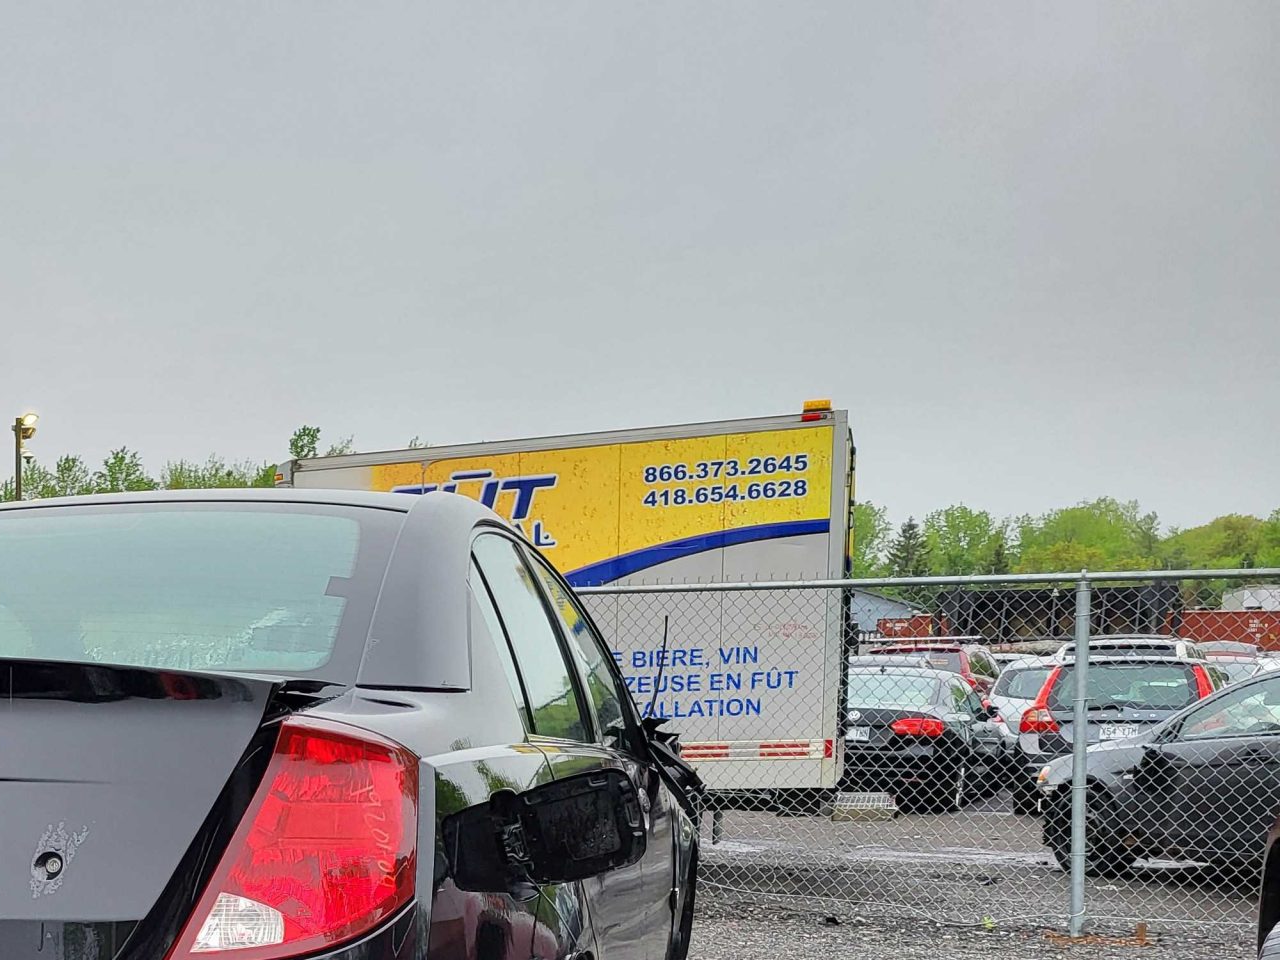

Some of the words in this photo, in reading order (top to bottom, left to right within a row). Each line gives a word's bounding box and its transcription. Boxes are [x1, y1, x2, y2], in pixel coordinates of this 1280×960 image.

[644, 454, 808, 483] 866.373.2645
[643, 479, 808, 507] 418.654.6628
[719, 646, 759, 665] VIN
[709, 672, 742, 691] EN
[751, 666, 799, 690] FÛT
